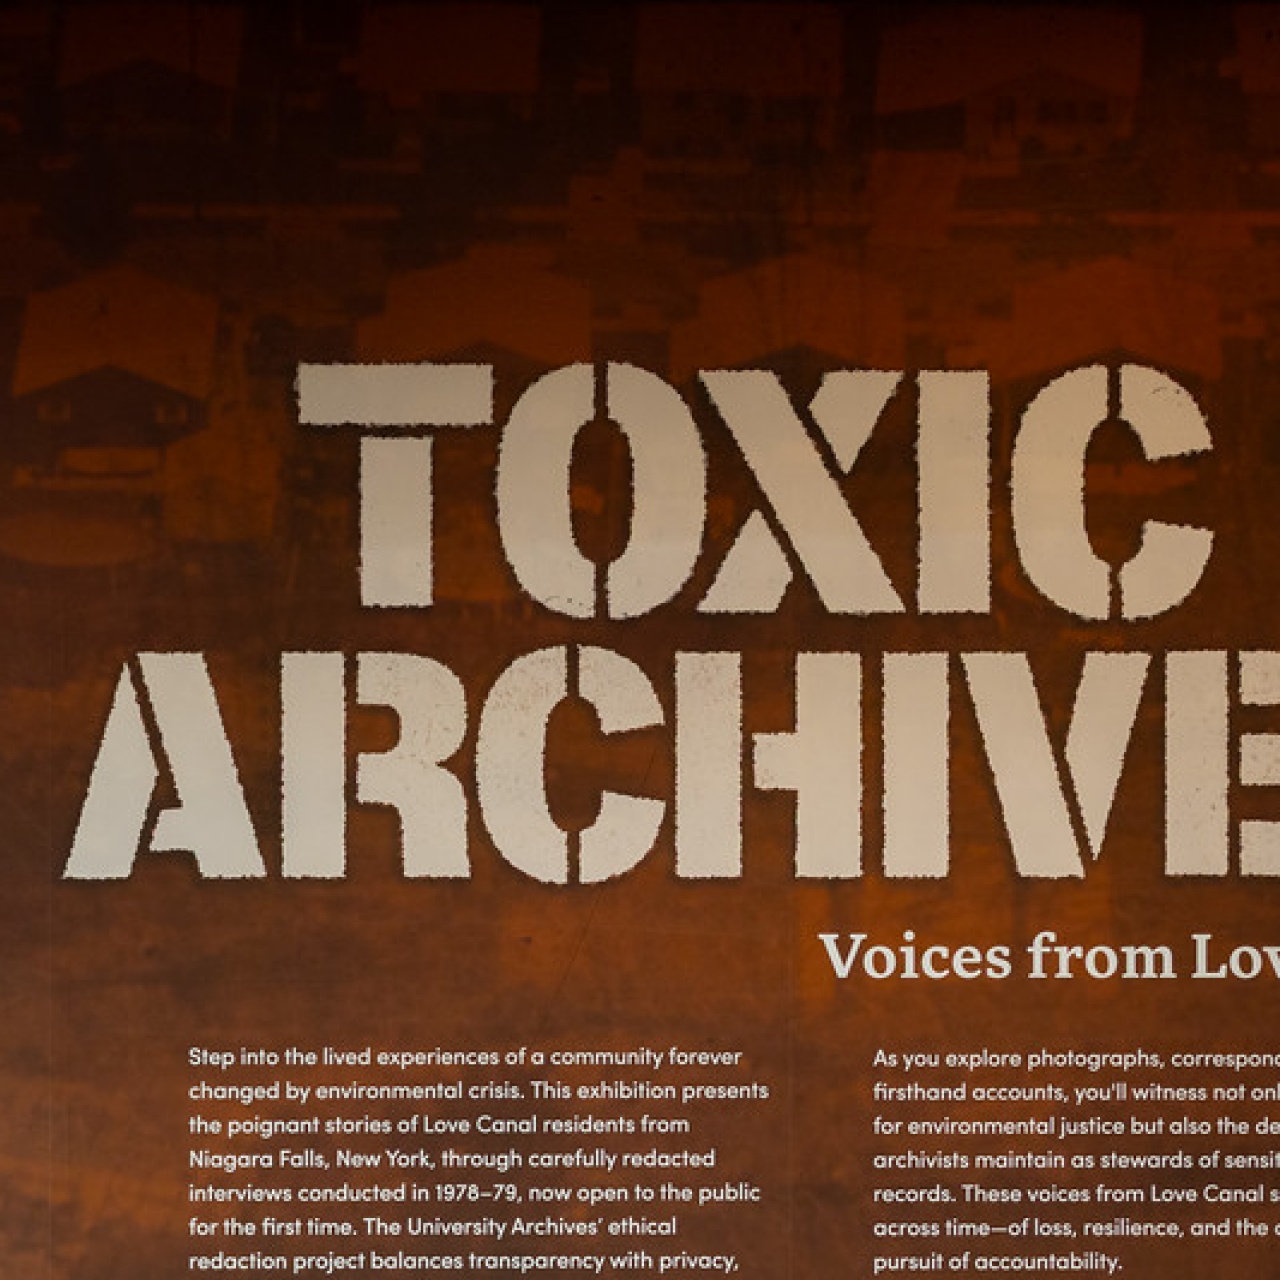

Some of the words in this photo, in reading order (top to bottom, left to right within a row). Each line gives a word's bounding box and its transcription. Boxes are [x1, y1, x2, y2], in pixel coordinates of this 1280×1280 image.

[297, 361, 1214, 620] TOXIC
[61, 645, 1280, 885] ARCHIVE
[819, 930, 1011, 978] Voices
[1028, 932, 1177, 978] from
[190, 1047, 235, 1070] Step
[241, 1048, 280, 1066] into
[284, 1047, 318, 1065] the
[324, 1047, 371, 1066] lived
[377, 1048, 501, 1070] experiences
[505, 1047, 527, 1065] of
[531, 1052, 544, 1065] a
[550, 1047, 664, 1070] community
[668, 1047, 743, 1065] forever
[874, 1050, 899, 1068] As
[903, 1054, 940, 1072] you
[946, 1050, 1022, 1072] explore
[1028, 1049, 1165, 1072] photographs,
[188, 1081, 280, 1106] changed
[286, 1081, 311, 1104] by
[315, 1081, 463, 1101] environmental
[469, 1081, 525, 1099] crisis.
[531, 1081, 573, 1099] This
[577, 1081, 676, 1099] exhibition
[682, 1083, 770, 1104] presents
[874, 1083, 967, 1101] firsthand
[973, 1084, 1069, 1104] accounts,
[1075, 1083, 1127, 1106] you'll
[1132, 1084, 1207, 1101] witness
[1213, 1086, 1245, 1101] not
[189, 1115, 223, 1135] the
[228, 1115, 321, 1140] poignant
[325, 1115, 393, 1135] stories
[397, 1115, 419, 1134] of
[424, 1115, 472, 1134] Love
[476, 1115, 537, 1134] Canal
[543, 1115, 636, 1134] residents
[641, 1115, 690, 1133] from
[874, 1117, 904, 1135] for
[908, 1117, 1055, 1135] environmental
[1059, 1117, 1125, 1140] justice
[1131, 1117, 1165, 1135] but
[1170, 1117, 1212, 1135] also
[1217, 1117, 1250, 1135] the
[190, 1151, 273, 1173] Niagara
[280, 1149, 330, 1171] Falls,
[337, 1150, 381, 1169] New
[385, 1149, 436, 1171] York,
[442, 1149, 523, 1173] through
[529, 1148, 618, 1173] carefully
[622, 1148, 715, 1168] redacted
[874, 1151, 969, 1169] archivists
[975, 1151, 1065, 1169] maintain
[1071, 1156, 1096, 1169] as
[1100, 1151, 1194, 1169] stewards
[1199, 1151, 1221, 1169] of
[190, 1184, 292, 1202] interviews
[298, 1182, 406, 1202] conducted
[413, 1184, 429, 1202] in
[529, 1189, 573, 1202] now
[577, 1189, 629, 1207] open
[634, 1184, 655, 1202] to
[661, 1182, 693, 1202] the
[699, 1182, 760, 1205] public
[874, 1184, 957, 1203] records.
[961, 1184, 1022, 1202] These
[1028, 1185, 1091, 1202] voices
[1096, 1184, 1144, 1202] from
[1152, 1185, 1199, 1202] Love
[1203, 1184, 1264, 1202] Canal
[189, 1218, 220, 1236] for
[224, 1218, 256, 1236] the
[262, 1218, 302, 1236] first
[308, 1218, 357, 1236] time.
[363, 1218, 402, 1236] The
[408, 1218, 508, 1241] University
[512, 1218, 604, 1236] Archives'
[608, 1216, 676, 1236] ethical
[874, 1223, 940, 1236] across
[1035, 1218, 1077, 1238] loss,
[1084, 1218, 1185, 1238] resilience,
[1191, 1218, 1231, 1236] and
[1237, 1218, 1269, 1236] the
[190, 1252, 288, 1270] redaction
[294, 1252, 366, 1275] project
[371, 1251, 465, 1270] balances
[469, 1252, 606, 1274] transparency
[610, 1251, 654, 1269] with
[660, 1251, 739, 1274] privacy,
[874, 1252, 944, 1275] pursuit
[949, 1252, 971, 1271] of
[975, 1252, 1123, 1275] accountability.
